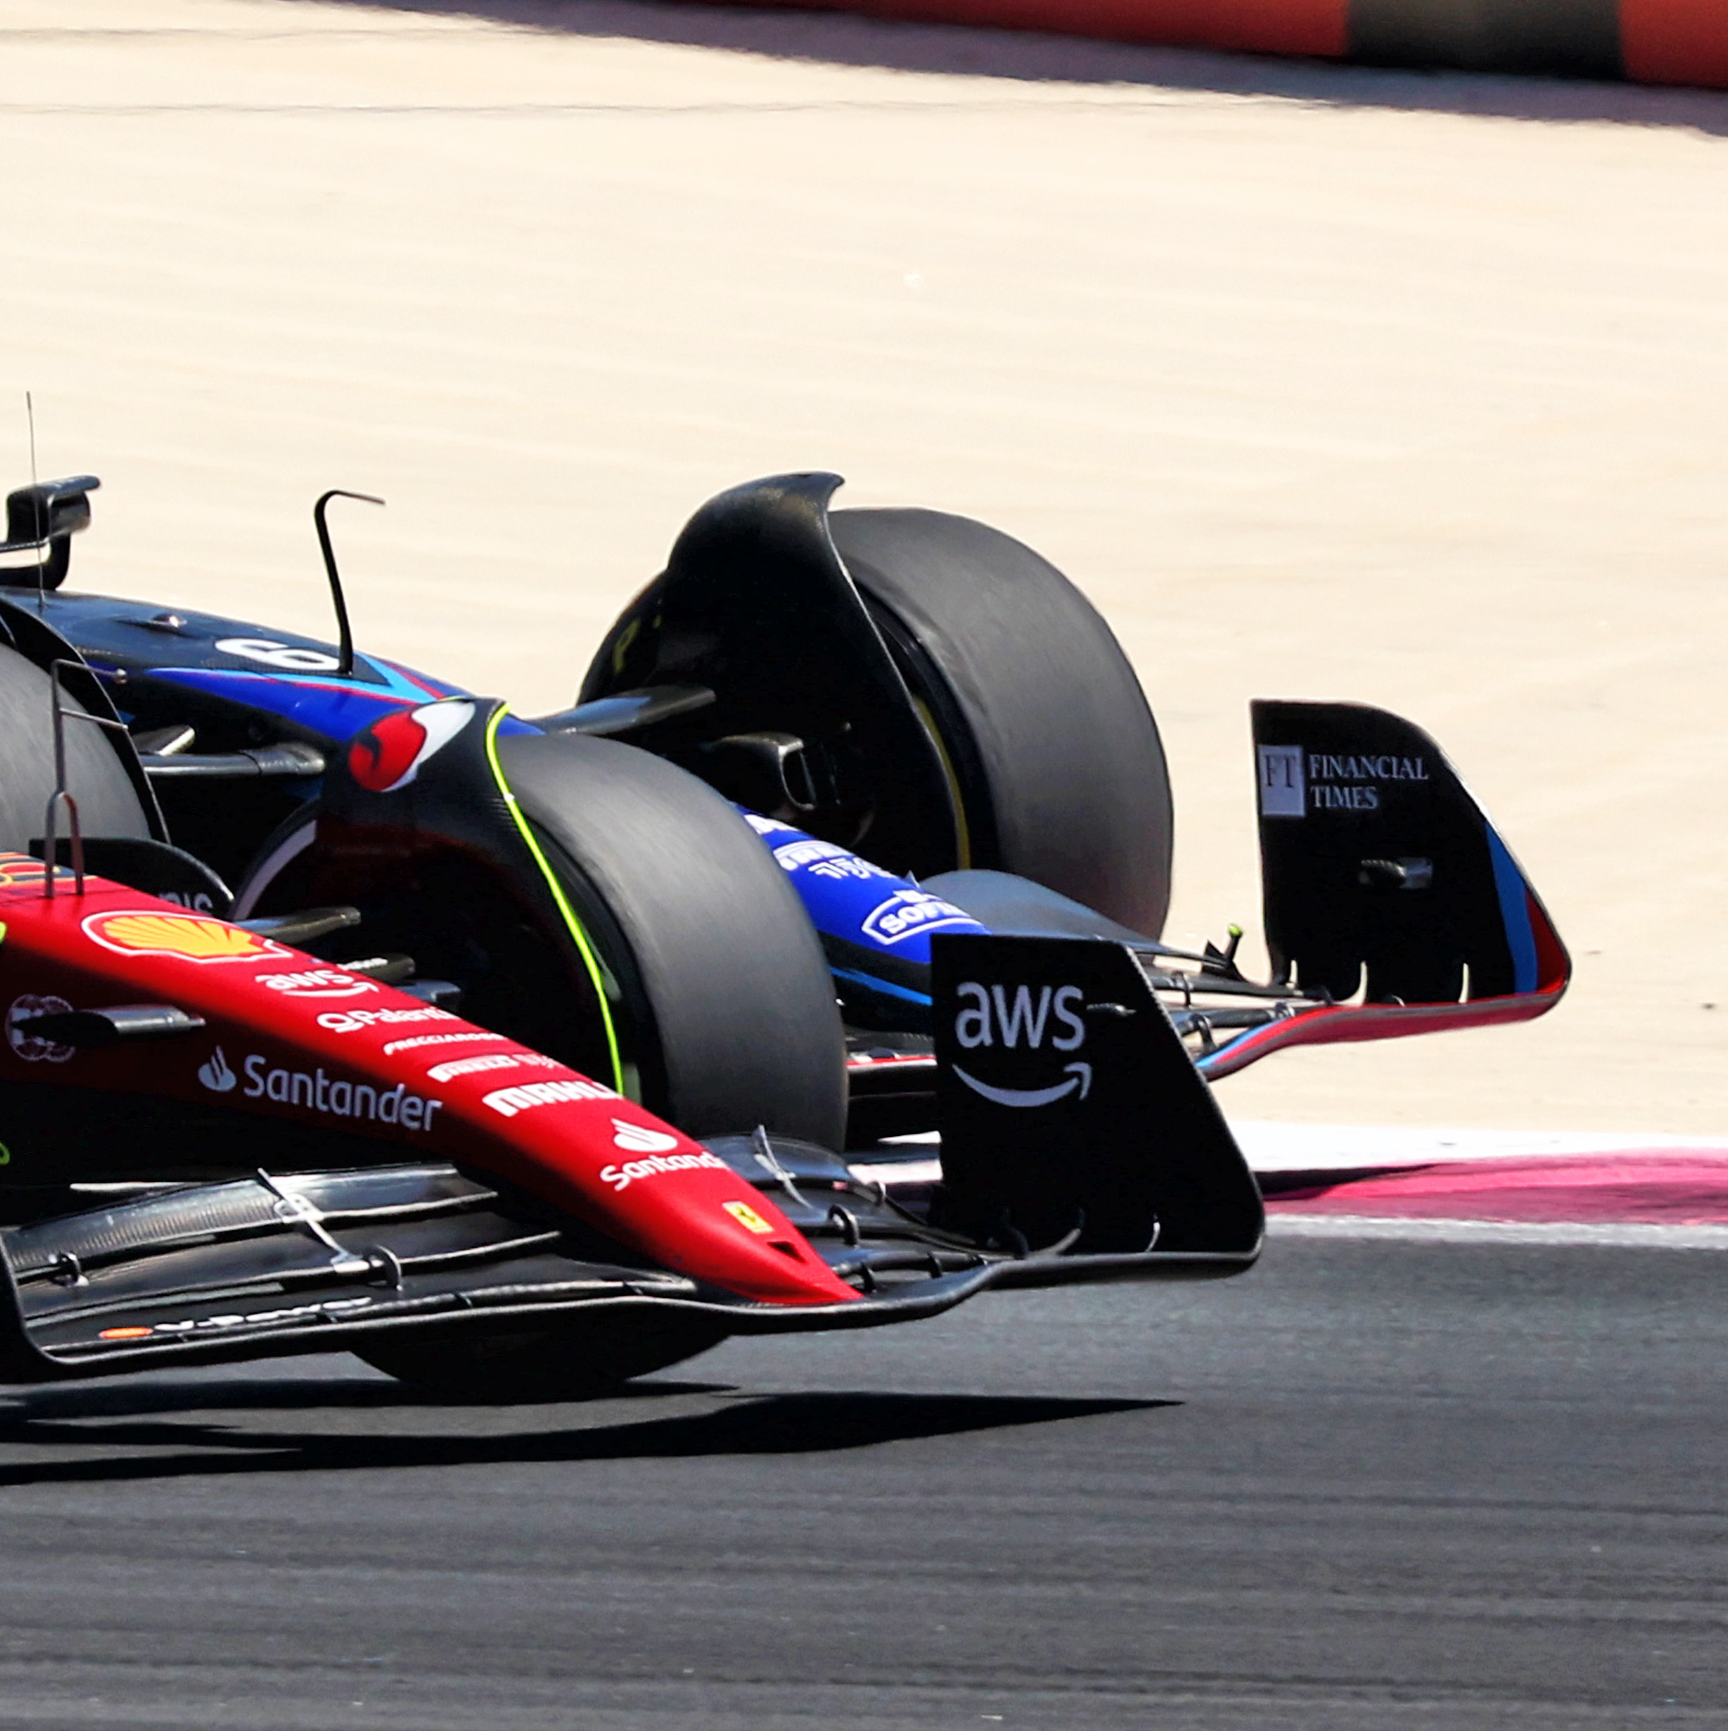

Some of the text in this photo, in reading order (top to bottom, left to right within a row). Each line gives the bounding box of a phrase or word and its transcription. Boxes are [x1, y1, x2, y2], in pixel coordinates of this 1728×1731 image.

[1265, 755, 1296, 789] FT
[1309, 754, 1429, 781] FINANCIAL
[1311, 786, 1379, 810] TIMES
[255, 968, 355, 991] aws
[954, 981, 1085, 1051] aws
[243, 1054, 443, 1132] Santander
